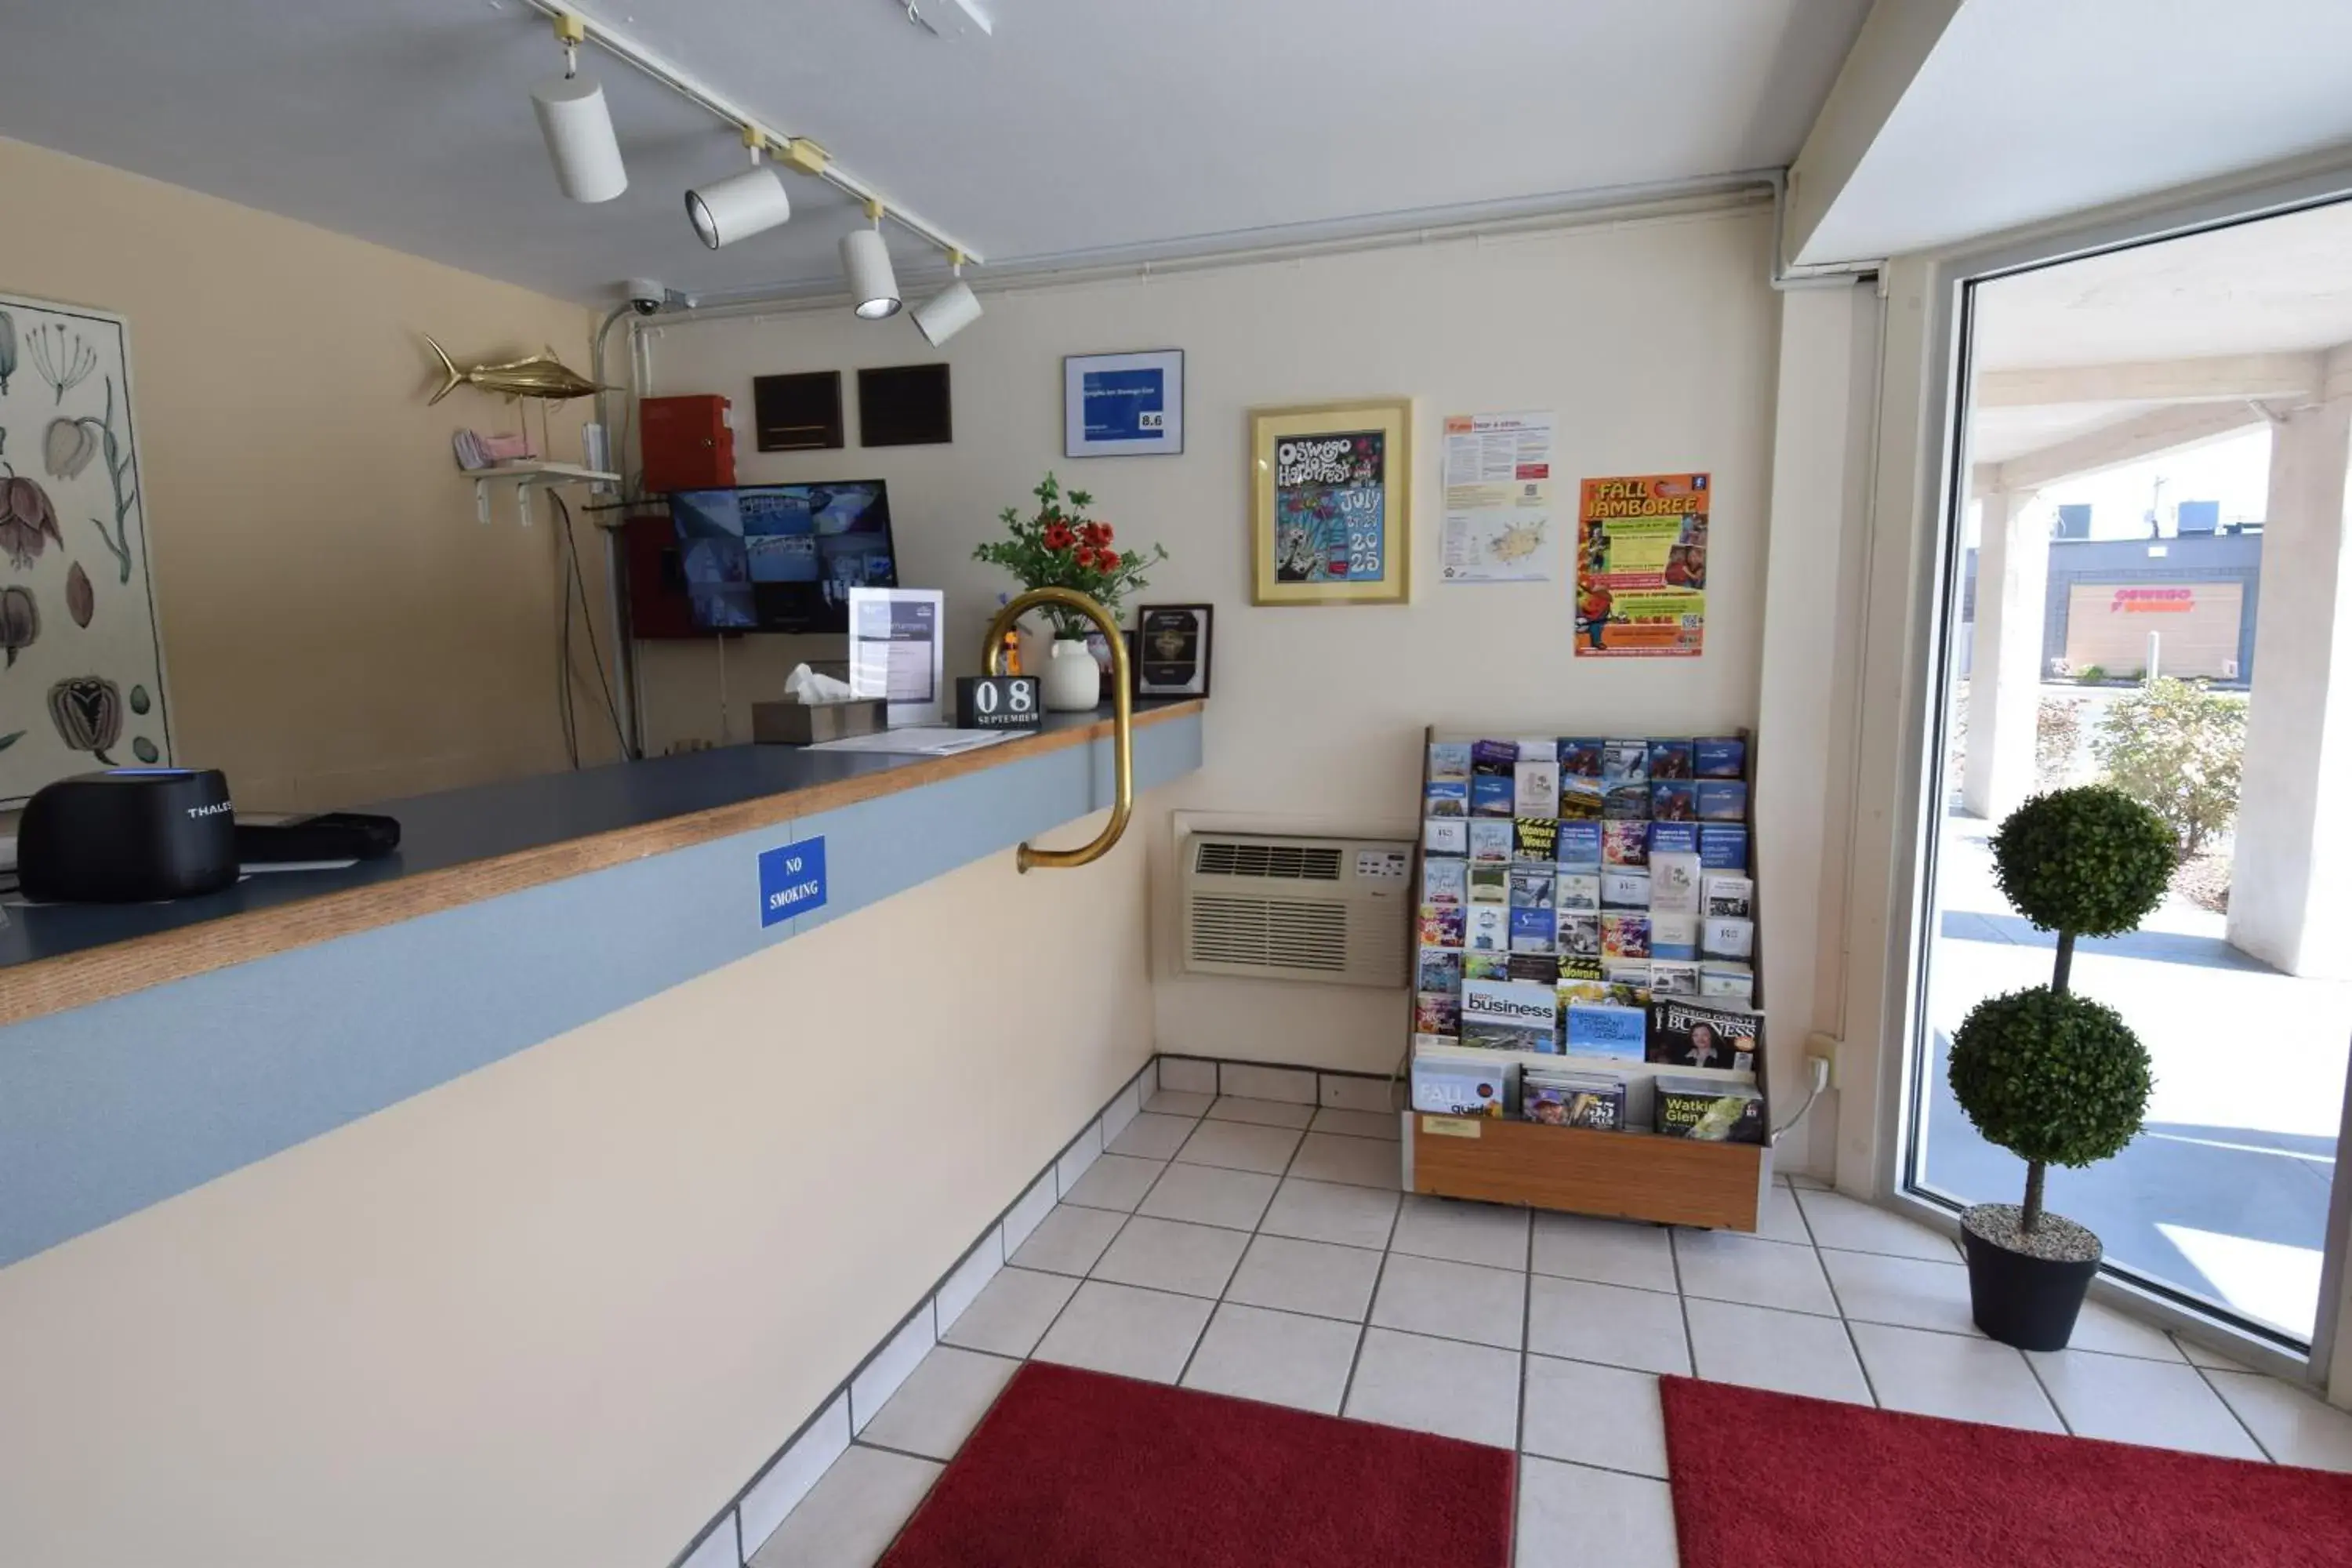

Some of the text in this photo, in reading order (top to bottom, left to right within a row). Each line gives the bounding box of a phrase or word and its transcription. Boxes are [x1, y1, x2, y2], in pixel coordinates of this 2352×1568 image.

[1598, 481, 1647, 499] FALL
[1340, 488, 1380, 514] July
[1588, 496, 1698, 517] JAMBOREE
[1351, 533, 1377, 550] 20
[1351, 552, 1379, 572] 25
[978, 713, 1039, 724] SEPTEMBER
[786, 856, 803, 877] NO
[769, 879, 818, 910] SMOKING
[1468, 991, 1554, 1018] business
[1668, 1013, 1755, 1038] BUNESS
[1666, 1109, 1699, 1123] Glen
